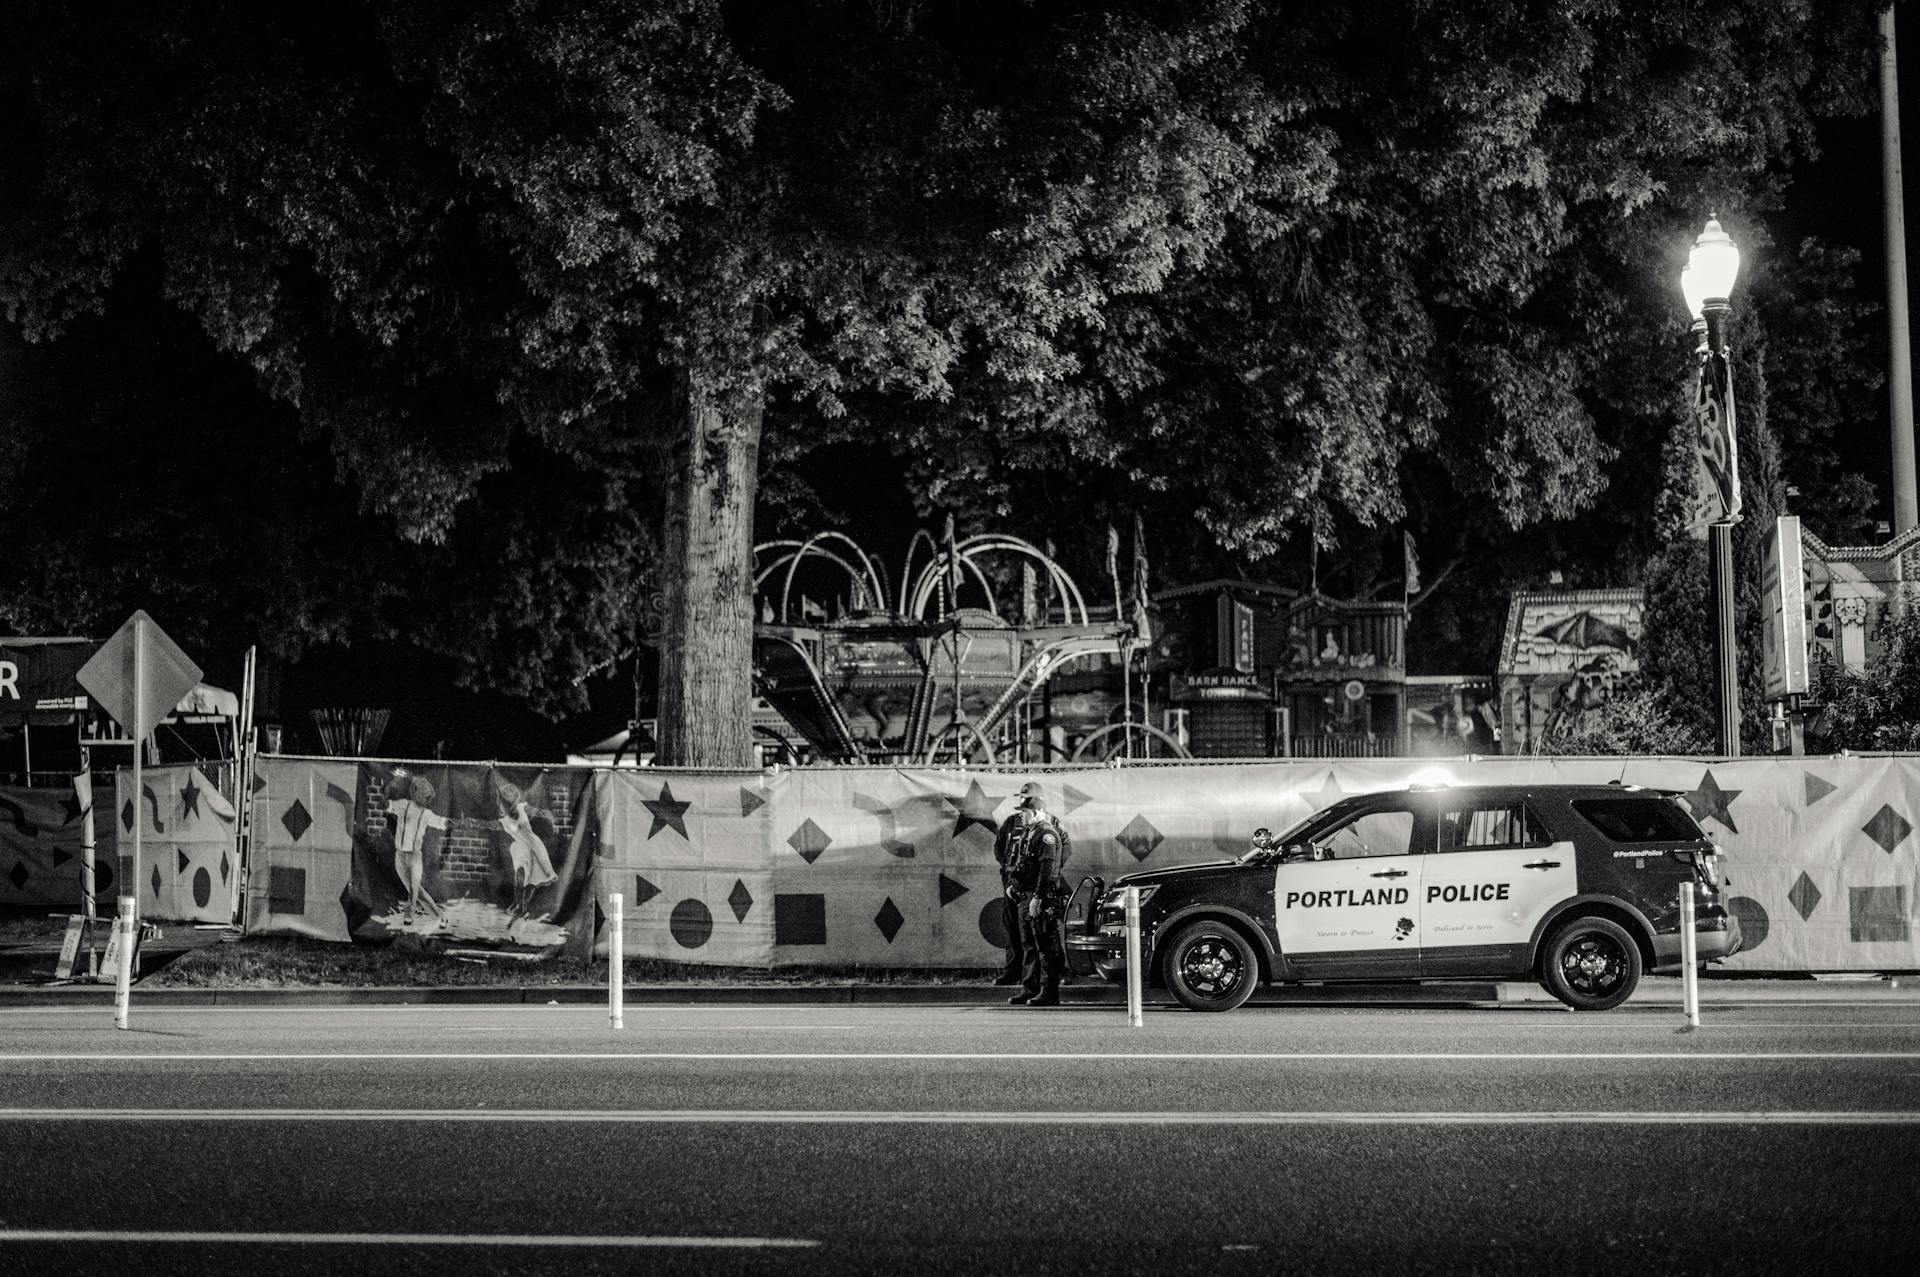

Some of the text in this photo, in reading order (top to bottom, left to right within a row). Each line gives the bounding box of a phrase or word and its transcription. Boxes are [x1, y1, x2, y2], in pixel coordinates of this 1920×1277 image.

[1188, 676, 1257, 686] BARN DANCE
[1613, 850, 1663, 858] @PortlandPolice
[1286, 883, 1510, 909] PORTLAND POLICE
